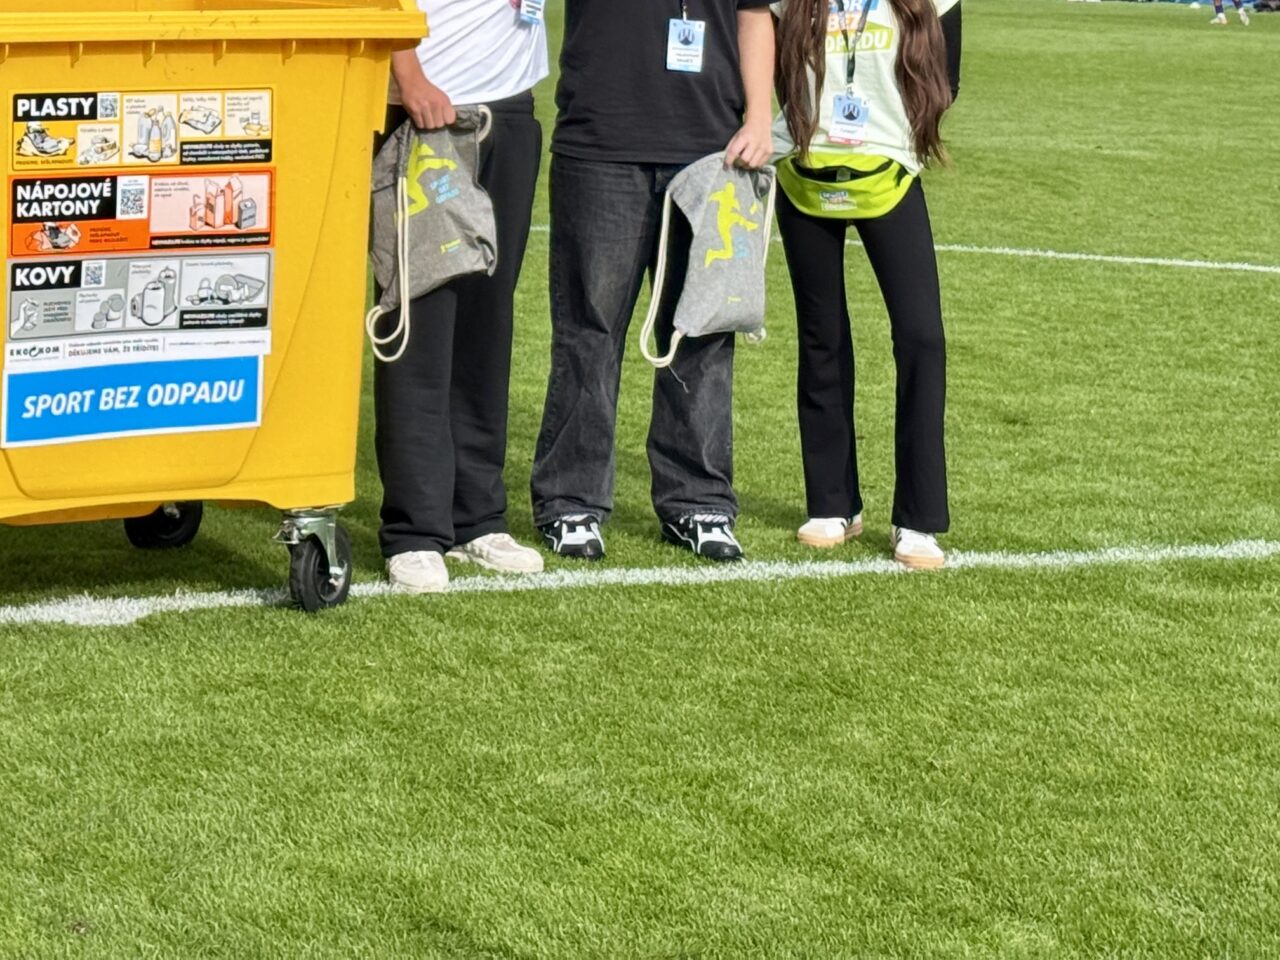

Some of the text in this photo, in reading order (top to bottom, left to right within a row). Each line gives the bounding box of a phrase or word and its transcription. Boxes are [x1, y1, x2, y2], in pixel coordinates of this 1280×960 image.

[17, 97, 95, 117] PLASTY
[16, 178, 112, 200] NÁPOJOVÉ
[16, 200, 101, 218] KARTONY
[15, 266, 76, 287] KOVY
[22, 379, 245, 418] SPORT BEZ ODPADU
